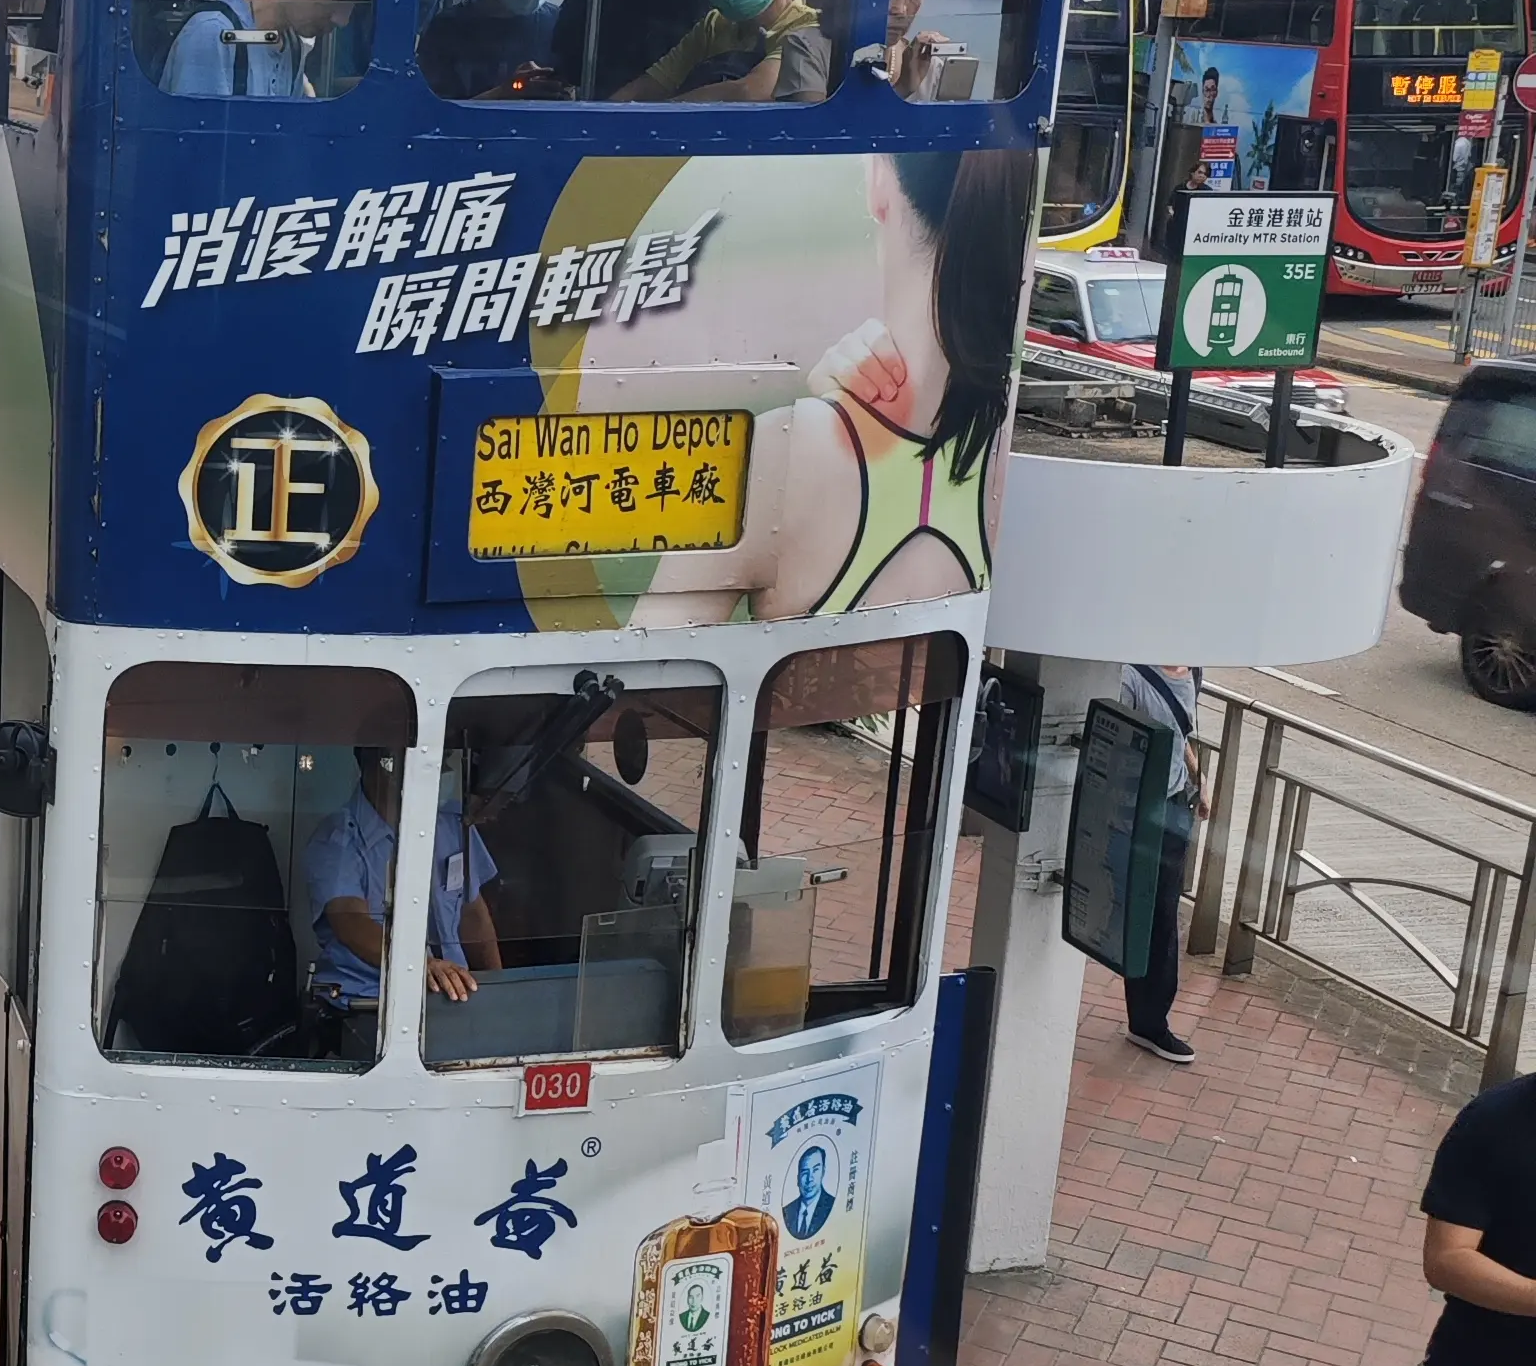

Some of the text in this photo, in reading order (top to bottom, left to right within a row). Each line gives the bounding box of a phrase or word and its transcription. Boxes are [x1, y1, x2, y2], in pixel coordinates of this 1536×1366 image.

[1391, 75, 1464, 96] 暫停服
[1226, 207, 1325, 229] 金鐘港鐵站
[1193, 232, 1321, 245] Admiralty MTR Station
[1098, 249, 1135, 260] TAXI
[355, 206, 722, 356] 瞬間輕鬆
[1282, 263, 1317, 280] 35E
[1285, 333, 1307, 346] 東行
[1258, 348, 1305, 357] Eastbound
[477, 413, 733, 461] Sai Wan Ho Depot
[224, 436, 340, 545] 正
[475, 461, 726, 520] 西灣河電車廠
[531, 1072, 581, 1100] 030
[268, 1268, 489, 1317] 活絡油
[769, 1308, 836, 1341] ONG TO YICK
